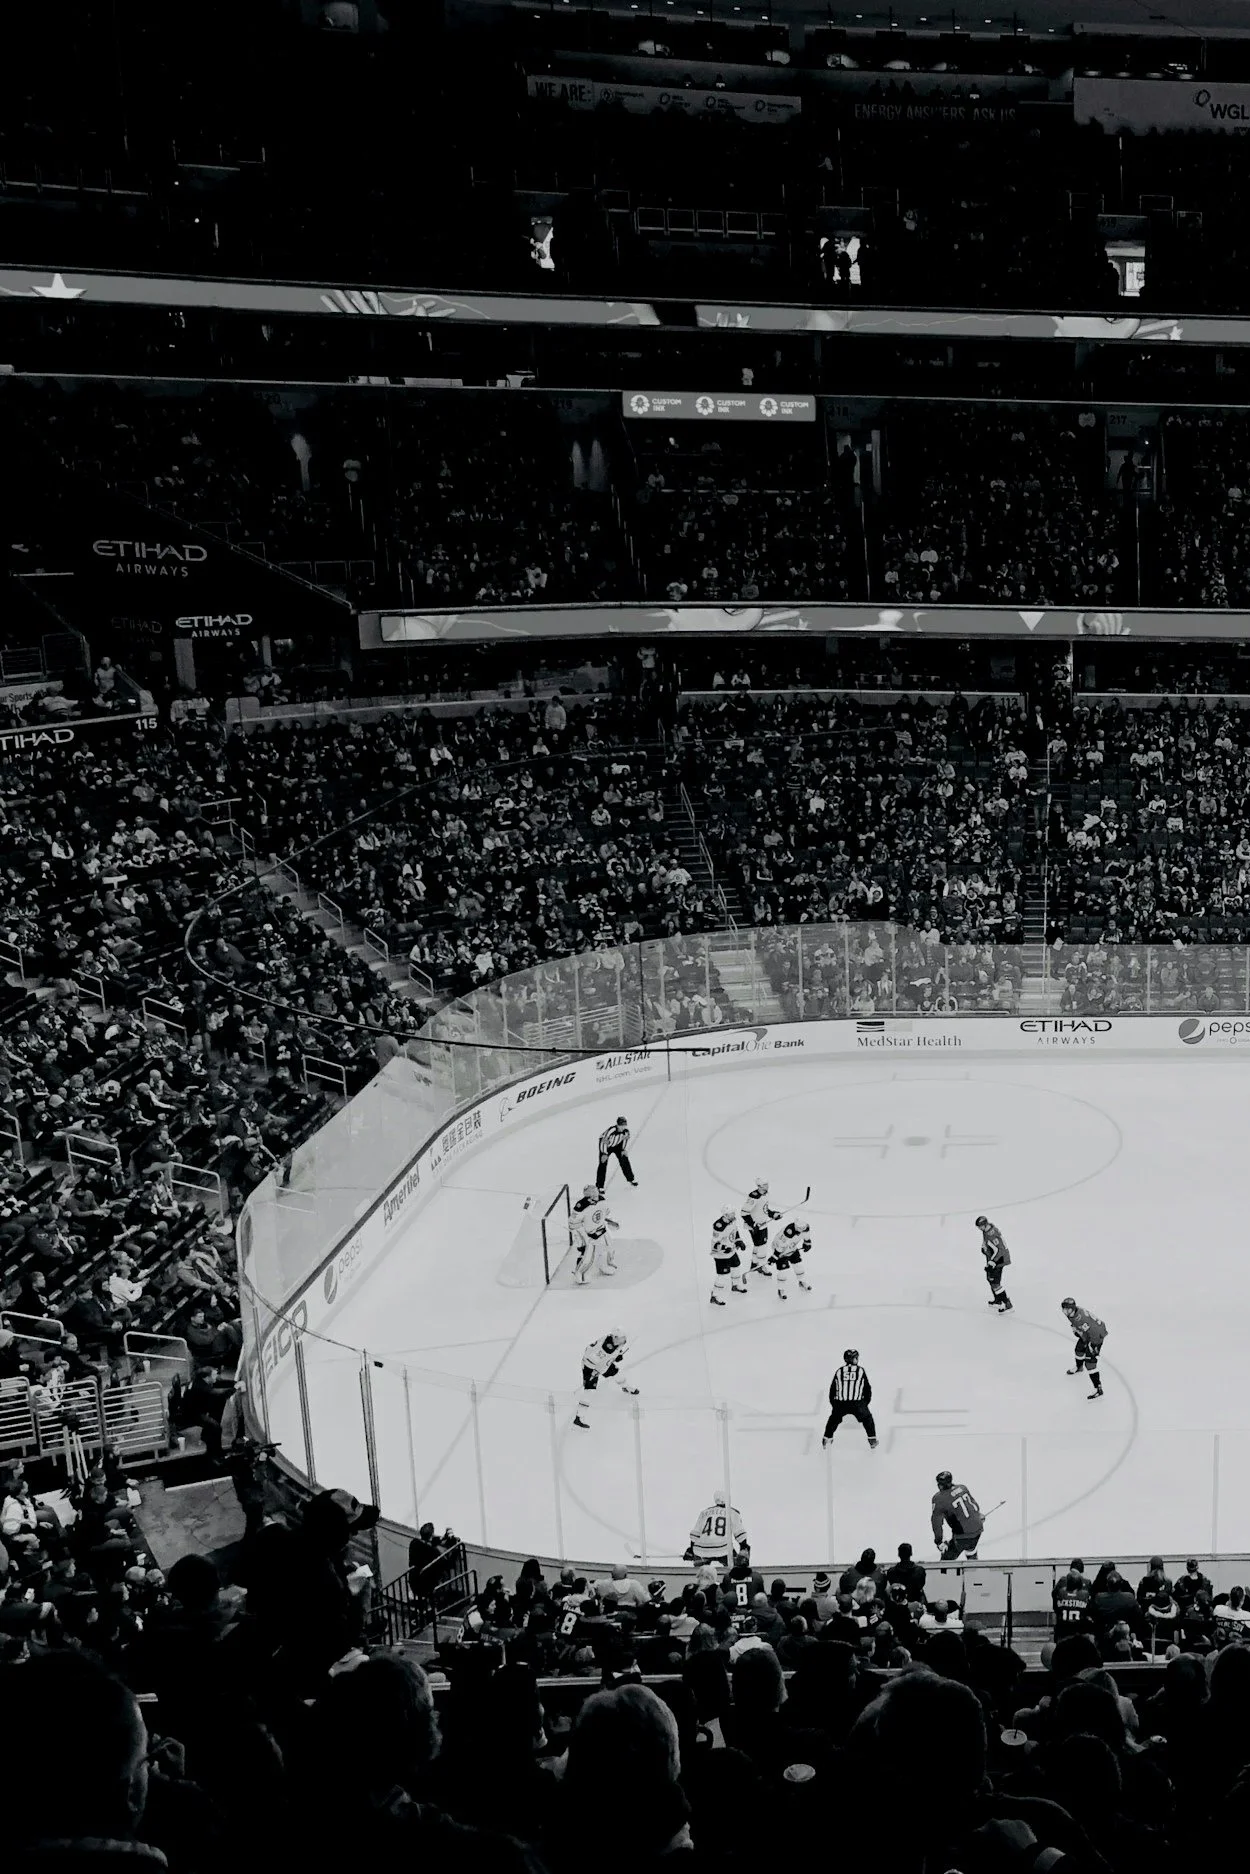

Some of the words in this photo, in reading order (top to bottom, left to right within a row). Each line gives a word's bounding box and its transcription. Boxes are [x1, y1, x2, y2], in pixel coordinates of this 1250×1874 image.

[535, 81, 551, 97] WE
[855, 103, 901, 120] ENERGY
[907, 105, 966, 121] ANSERS
[973, 107, 996, 121] ASK
[1210, 104, 1249, 119] WGL
[652, 398, 681, 406] CUSTOM
[93, 539, 208, 562] ETIHAD
[116, 563, 189, 578] AIRWAYS
[175, 614, 253, 628] ETIHAD
[191, 628, 240, 638] AIRWAYS
[135, 718, 158, 730] 115
[0, 729, 74, 751] TIHAD
[1020, 1019, 1112, 1033] ETIHAD
[774, 1038, 805, 1050] Bank
[857, 1034, 913, 1047] MedStar
[917, 1034, 962, 1047] Health
[1037, 1036, 1096, 1045] AIRWAYS
[516, 1071, 576, 1104] BOEING
[952, 1493, 979, 1518] 77
[702, 1516, 727, 1536] 48
[736, 1583, 749, 1606] 8
[561, 1612, 577, 1635] 8
